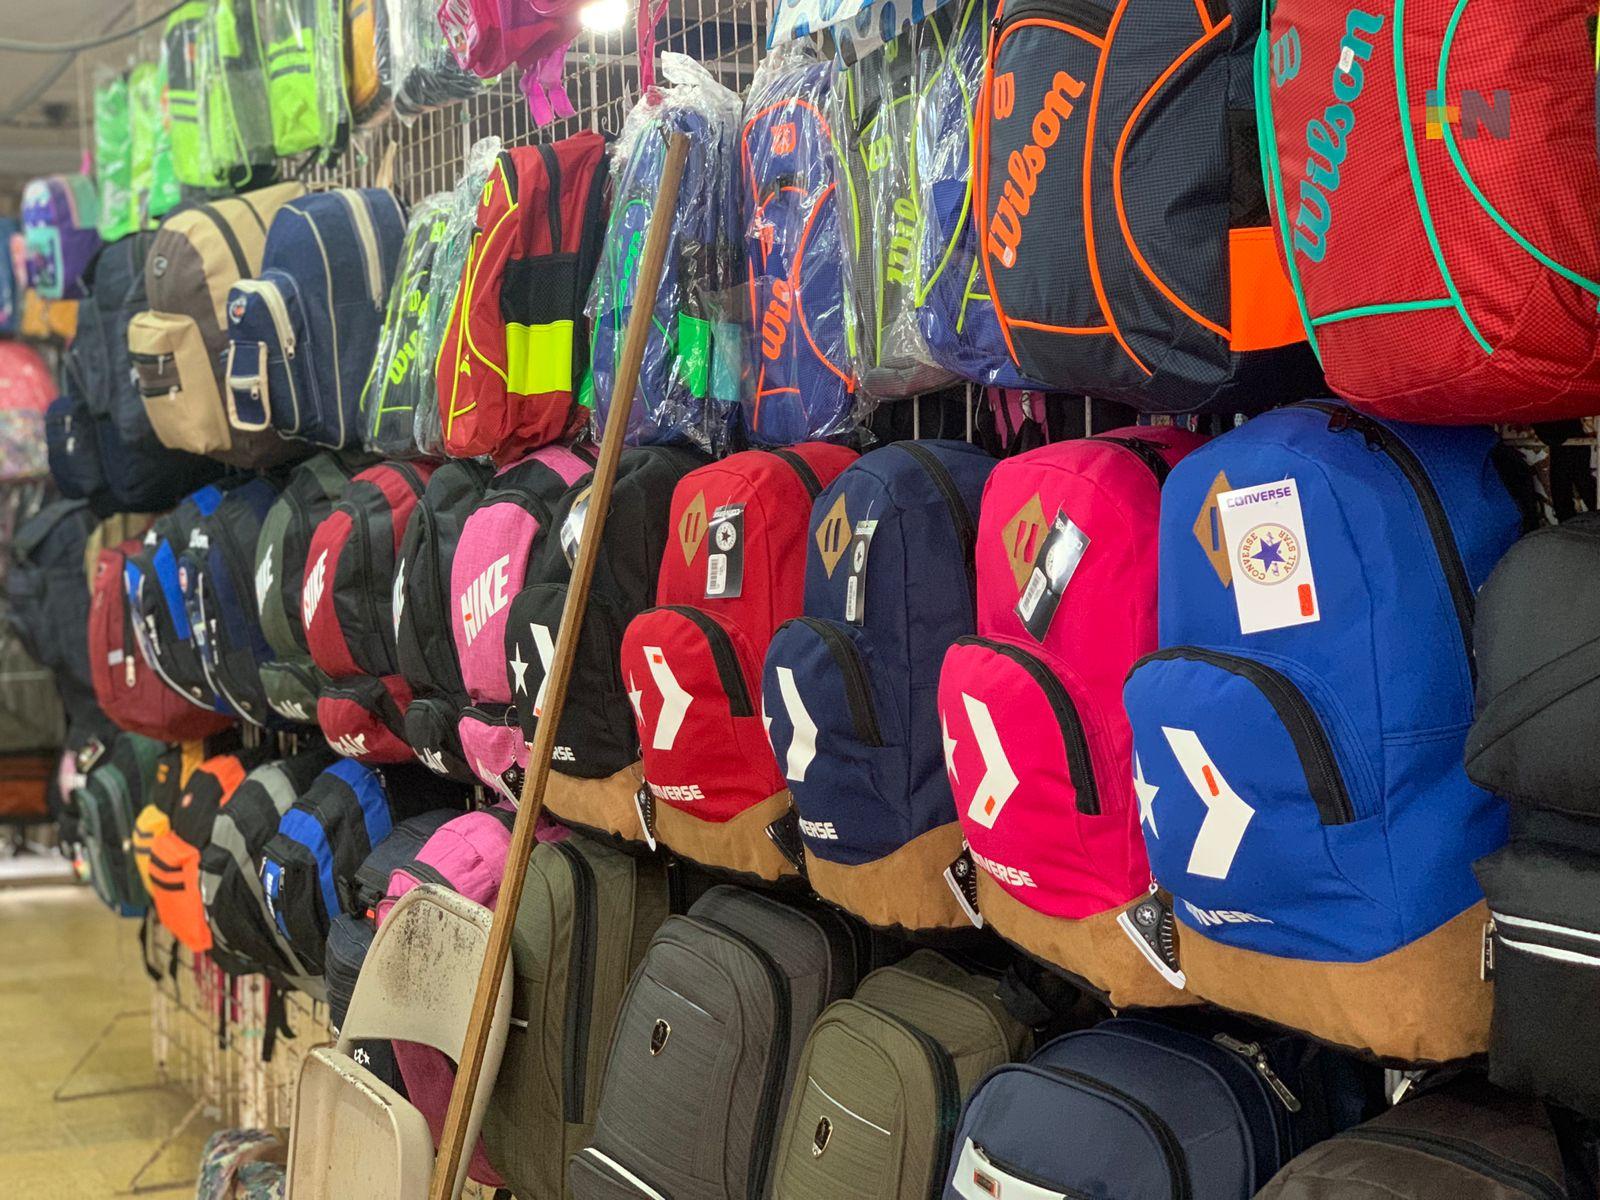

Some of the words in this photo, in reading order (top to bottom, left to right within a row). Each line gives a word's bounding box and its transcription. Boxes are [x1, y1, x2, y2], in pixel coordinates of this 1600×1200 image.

[1294, 8, 1385, 263] Wilson
[988, 70, 1087, 269] Wilson
[1226, 486, 1292, 508] CONVERSE
[1241, 532, 1267, 581] CONVERSE
[1278, 530, 1296, 552] STAR
[1284, 555, 1297, 574] ALL
[460, 553, 510, 648] NIKE
